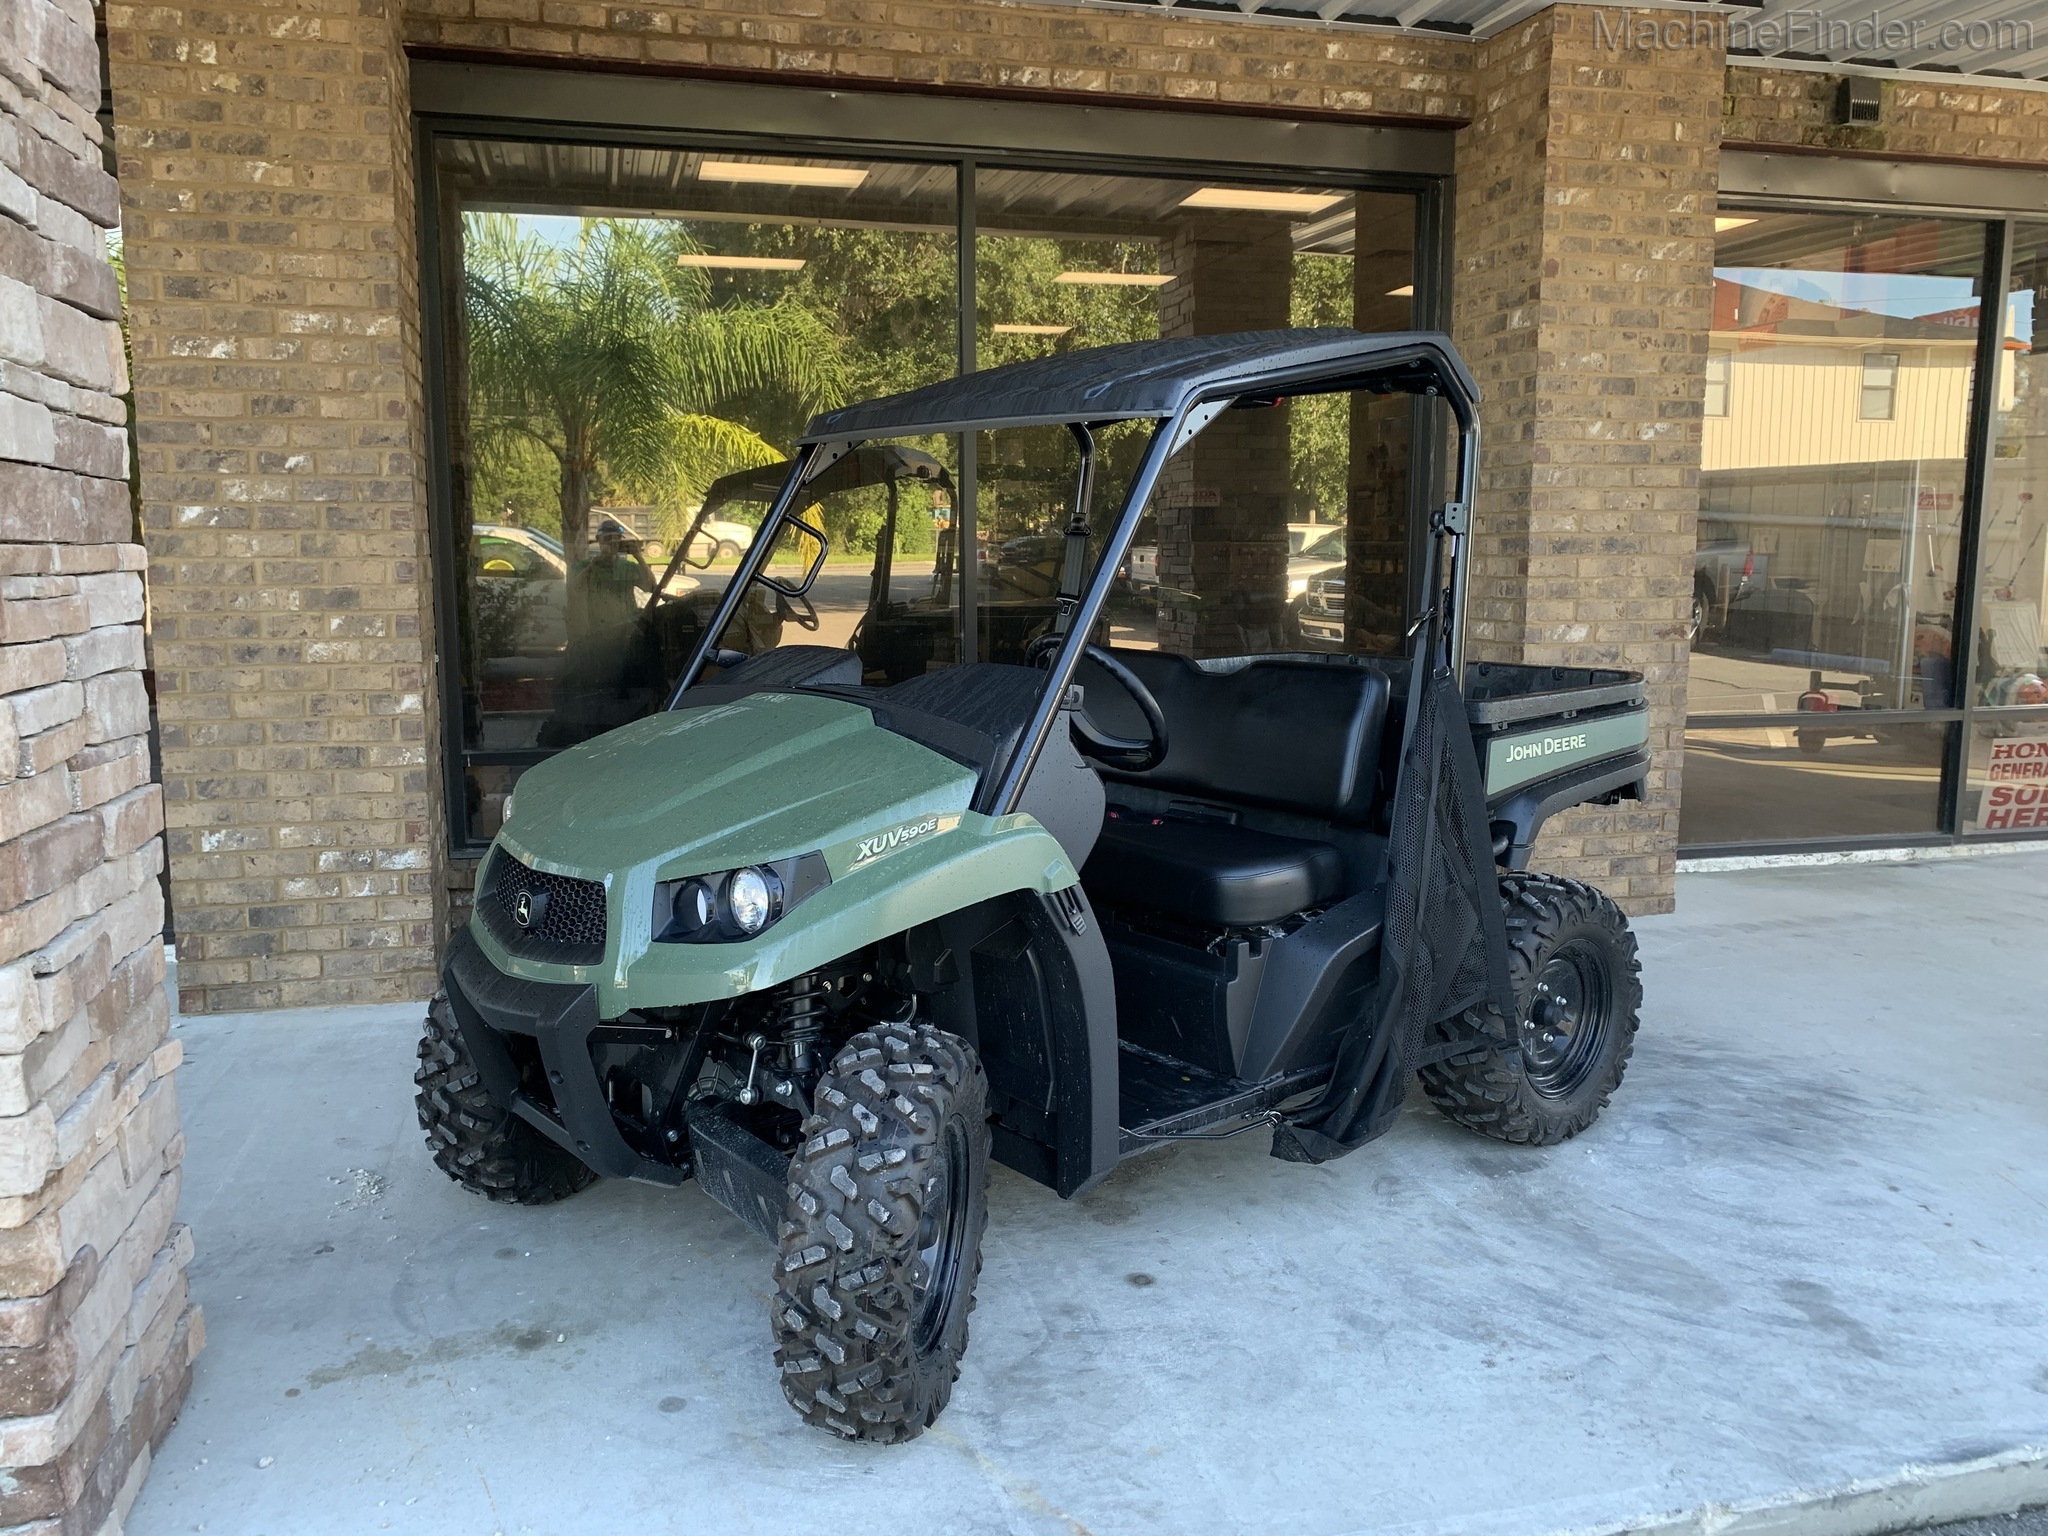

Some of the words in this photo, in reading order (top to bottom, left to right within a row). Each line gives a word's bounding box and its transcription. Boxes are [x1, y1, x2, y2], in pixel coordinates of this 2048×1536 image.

[1506, 742, 1542, 763] JOHN
[1544, 733, 1587, 755] DEERE
[856, 817, 938, 861] XUV590E
